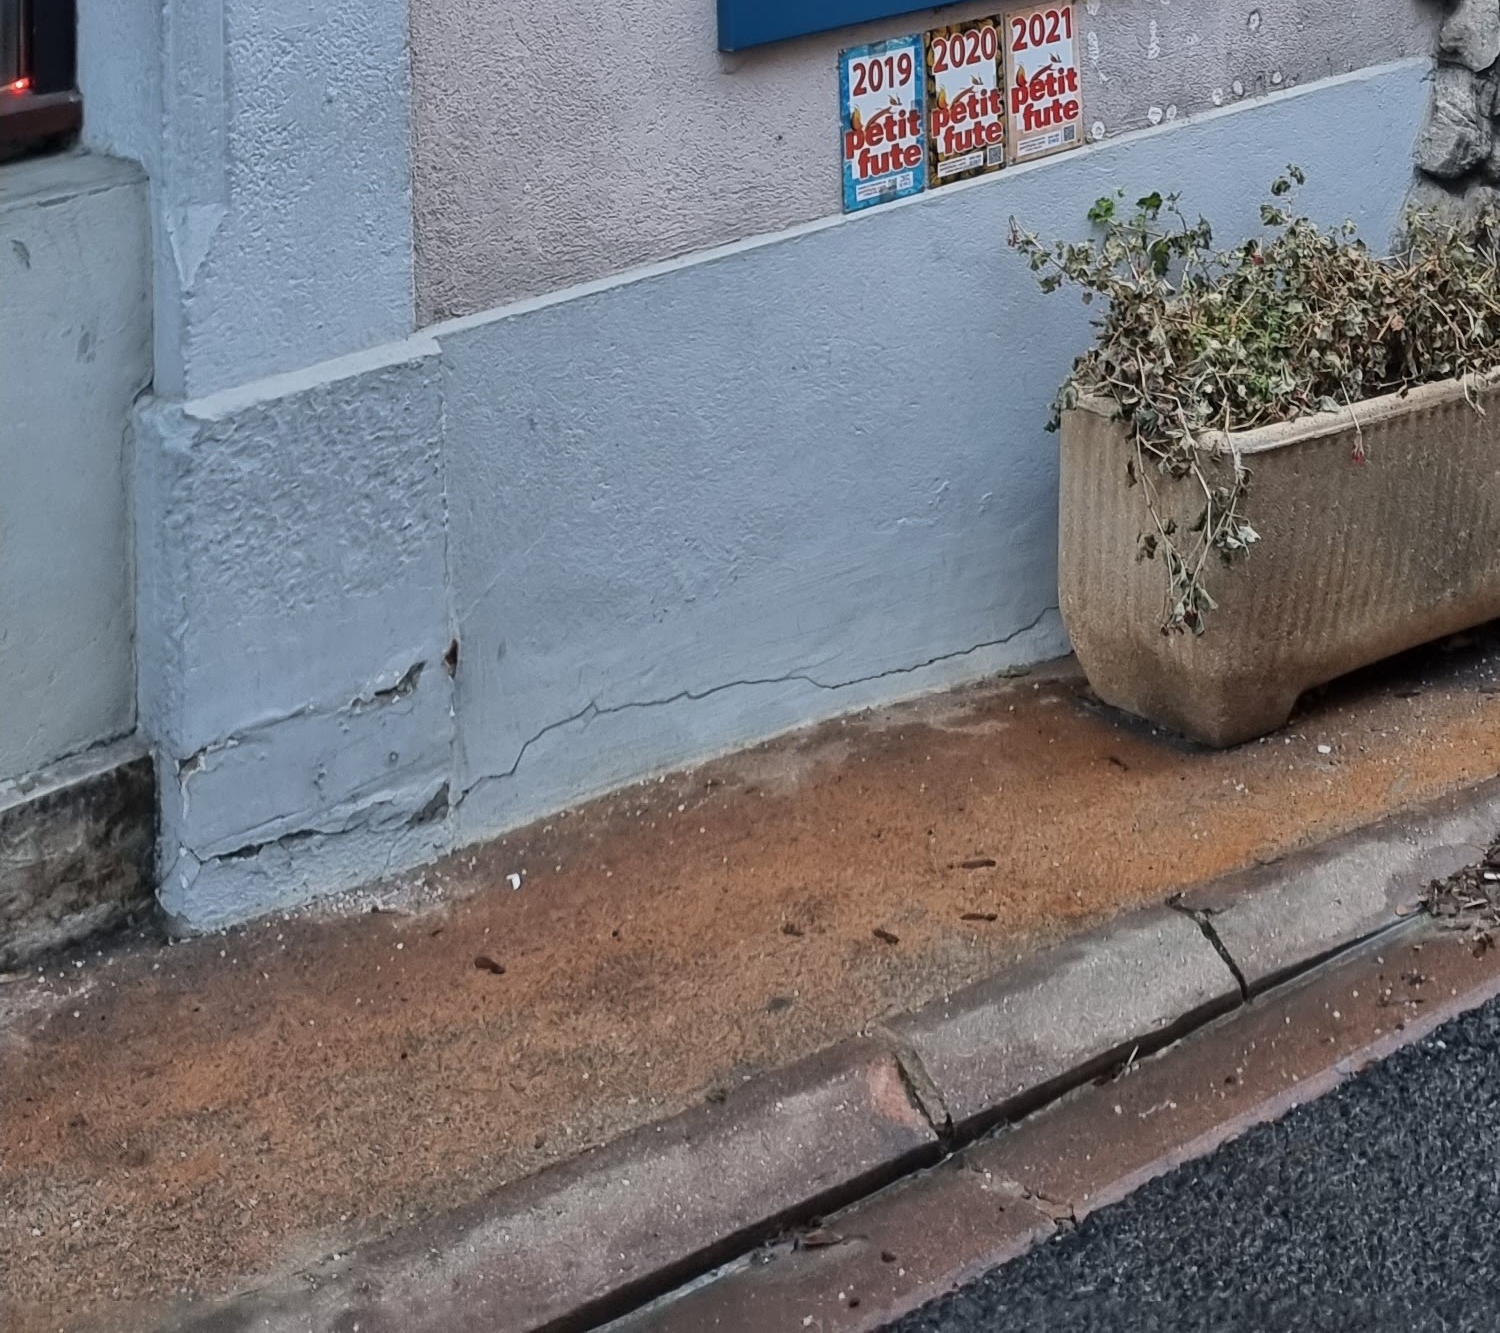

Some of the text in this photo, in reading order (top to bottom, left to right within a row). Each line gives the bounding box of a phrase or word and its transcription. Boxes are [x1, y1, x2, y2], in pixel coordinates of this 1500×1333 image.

[932, 27, 997, 74] 2020
[1011, 7, 1072, 52] 2021
[852, 53, 912, 96] 2019
[1011, 67, 1077, 114] petit
[845, 109, 921, 159] petit
[932, 89, 1001, 136] petit
